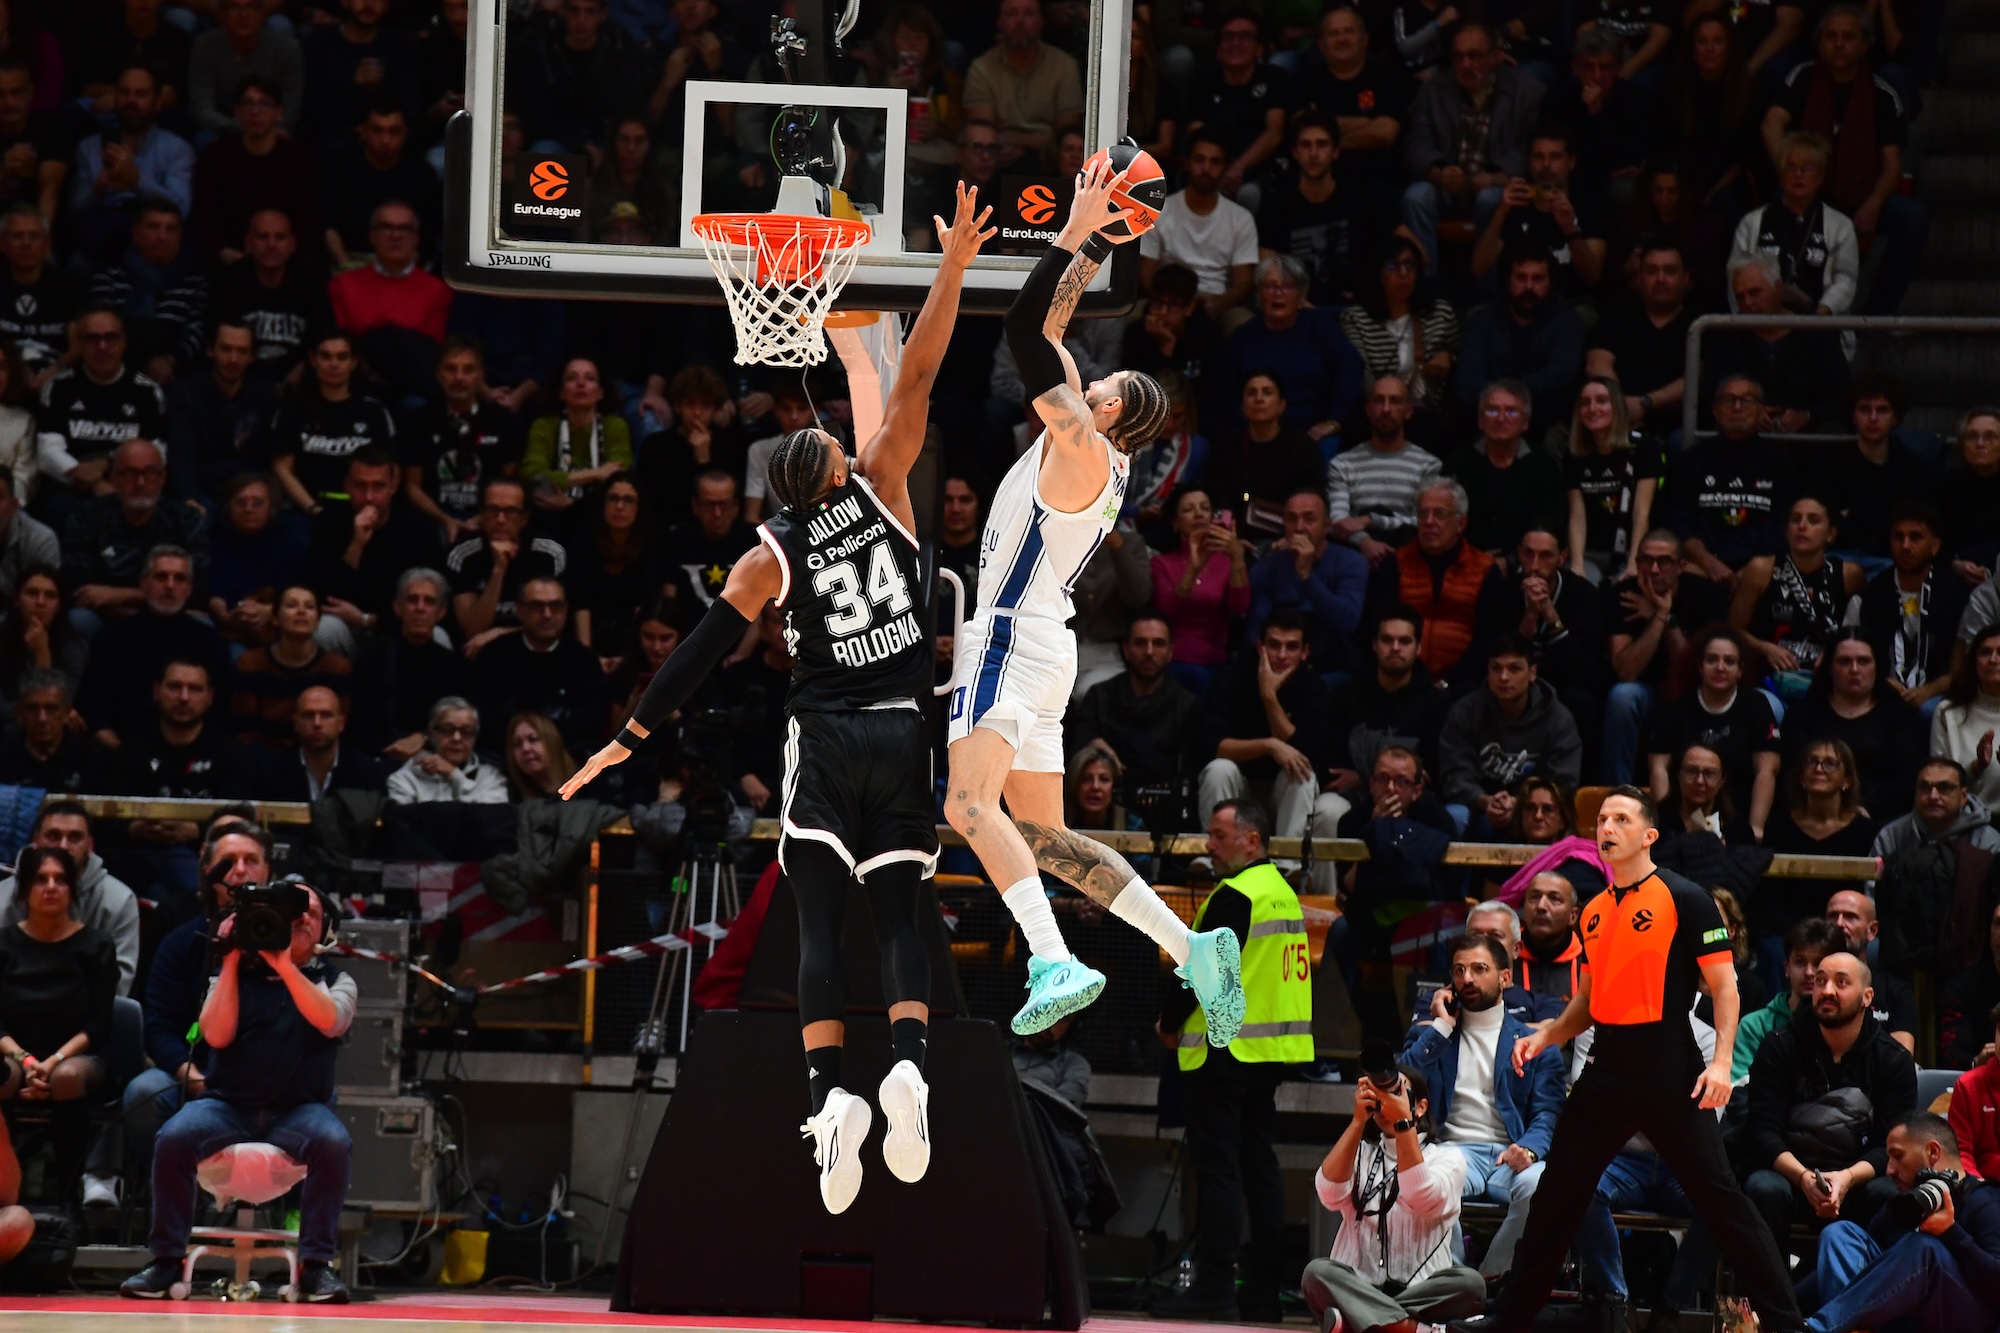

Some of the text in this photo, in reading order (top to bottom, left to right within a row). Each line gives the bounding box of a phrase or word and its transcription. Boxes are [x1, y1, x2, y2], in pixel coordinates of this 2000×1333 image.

[513, 203, 581, 219] EuroLeague
[1002, 227, 1059, 242] EuroLeag
[488, 253, 552, 268] SPALDING
[807, 495, 864, 546] JALLOW
[825, 517, 887, 562] Pelliconi
[812, 539, 913, 638] 34
[831, 611, 923, 669] BOLOGNA
